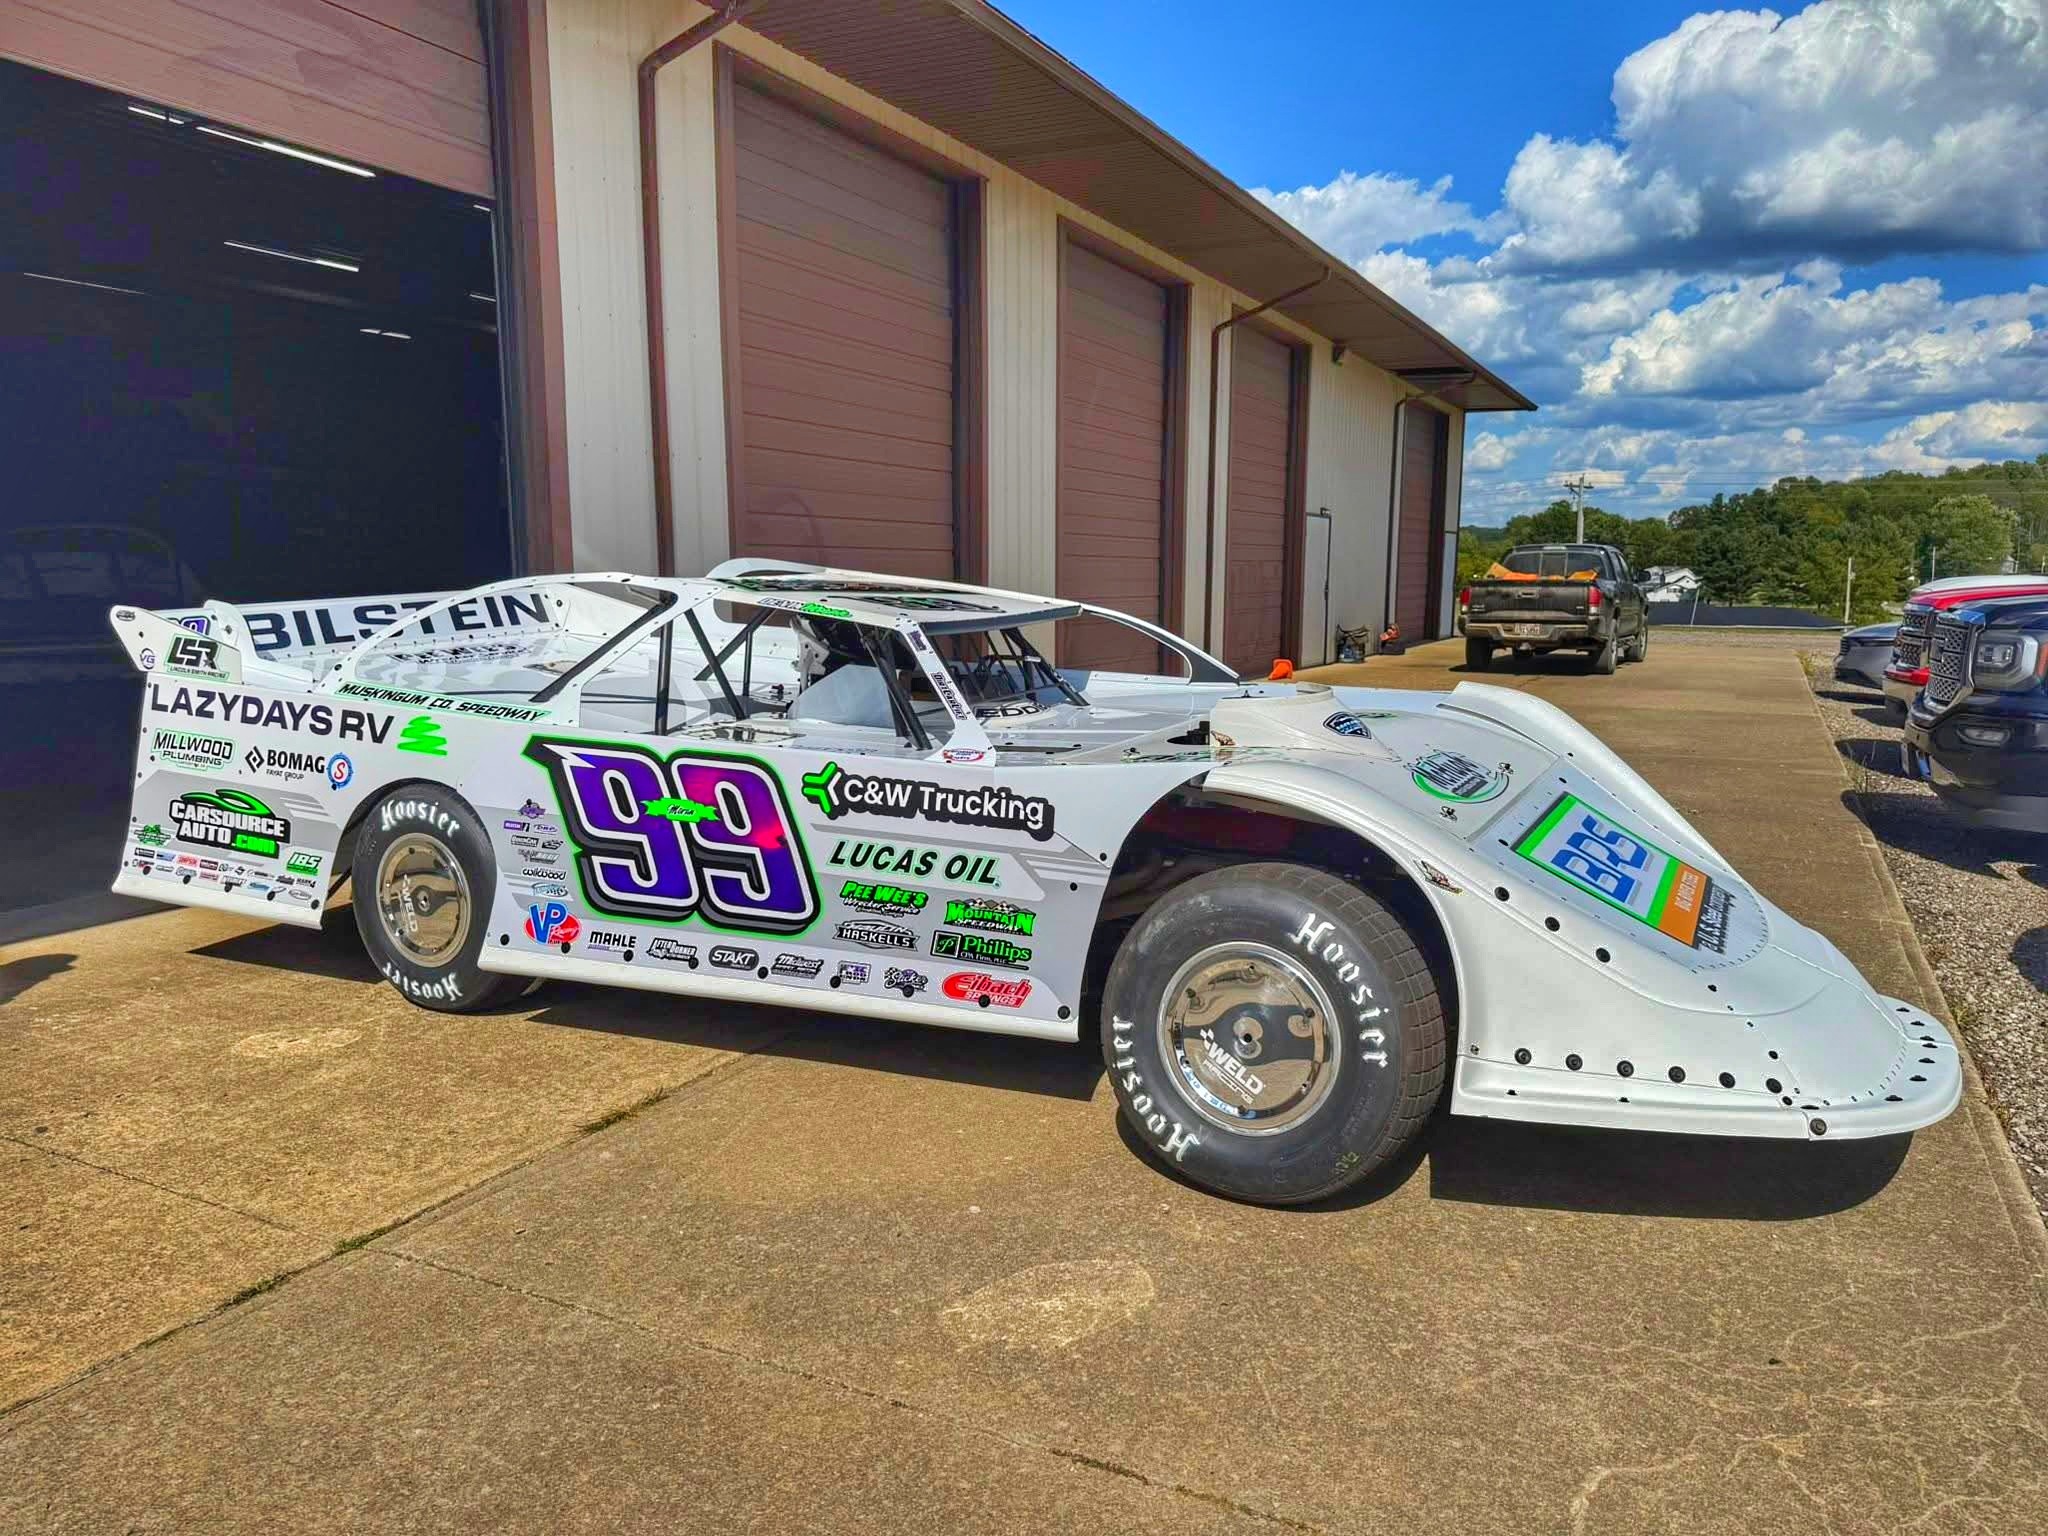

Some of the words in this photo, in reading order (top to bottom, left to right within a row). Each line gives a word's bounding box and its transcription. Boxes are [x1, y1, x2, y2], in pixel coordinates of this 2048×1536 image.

[246, 593, 549, 650] BILSTEIN
[167, 636, 219, 669] LSR
[151, 683, 333, 736] LAZYDAYS
[339, 709, 395, 744] RV
[338, 683, 427, 706] MUSKINGUM
[455, 702, 546, 721] SPEEDWAY
[153, 732, 233, 760] MILLWOOD
[162, 750, 223, 766] PLUMBING
[266, 750, 326, 774] BOMAG
[171, 802, 286, 837] CARSOURCE
[381, 800, 460, 837] Hoosier
[843, 779, 912, 808] C&W
[919, 786, 1044, 830] Trucking
[540, 741, 817, 926] 99
[829, 841, 938, 876] LUCAS
[944, 854, 998, 884] OIL
[841, 881, 873, 899] PEE
[530, 902, 567, 943] VP
[945, 902, 1034, 935] MOUNTAIN
[589, 931, 637, 948] MAHLE
[842, 928, 910, 947] HASKELLS
[962, 936, 1030, 961] Phillips
[711, 949, 755, 966] STAKT
[382, 963, 464, 1002] Hoosier
[955, 974, 1031, 997] Eibach
[965, 991, 1017, 1004] SPNGS
[1289, 912, 1388, 1069] Hoosier
[1208, 1041, 1264, 1095] WELD
[1112, 1015, 1201, 1162] Hoosier
